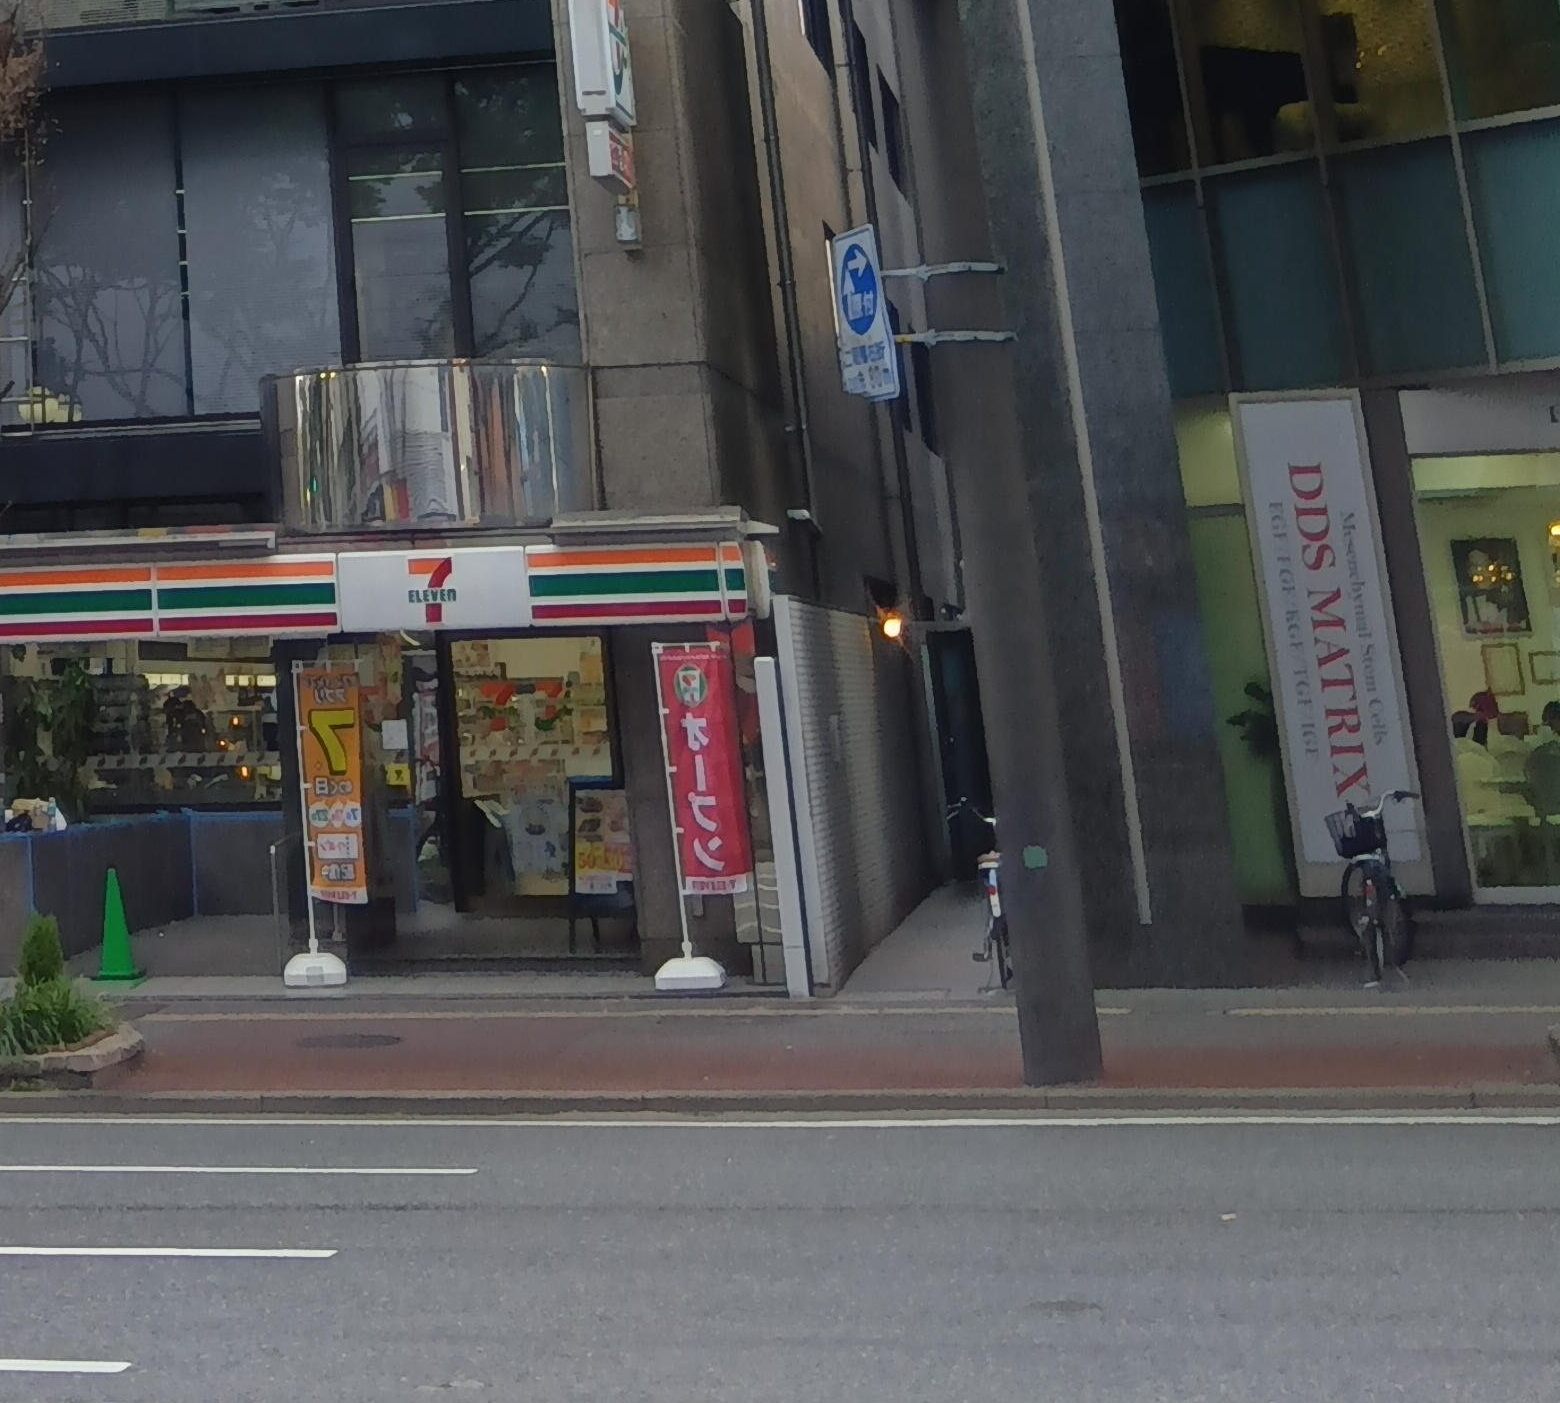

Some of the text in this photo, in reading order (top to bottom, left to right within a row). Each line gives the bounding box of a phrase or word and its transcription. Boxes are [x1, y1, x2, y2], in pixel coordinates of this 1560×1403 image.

[408, 557, 453, 623] 7
[1287, 461, 1371, 798] DDS MATRIX
[1361, 643, 1377, 693] Stem
